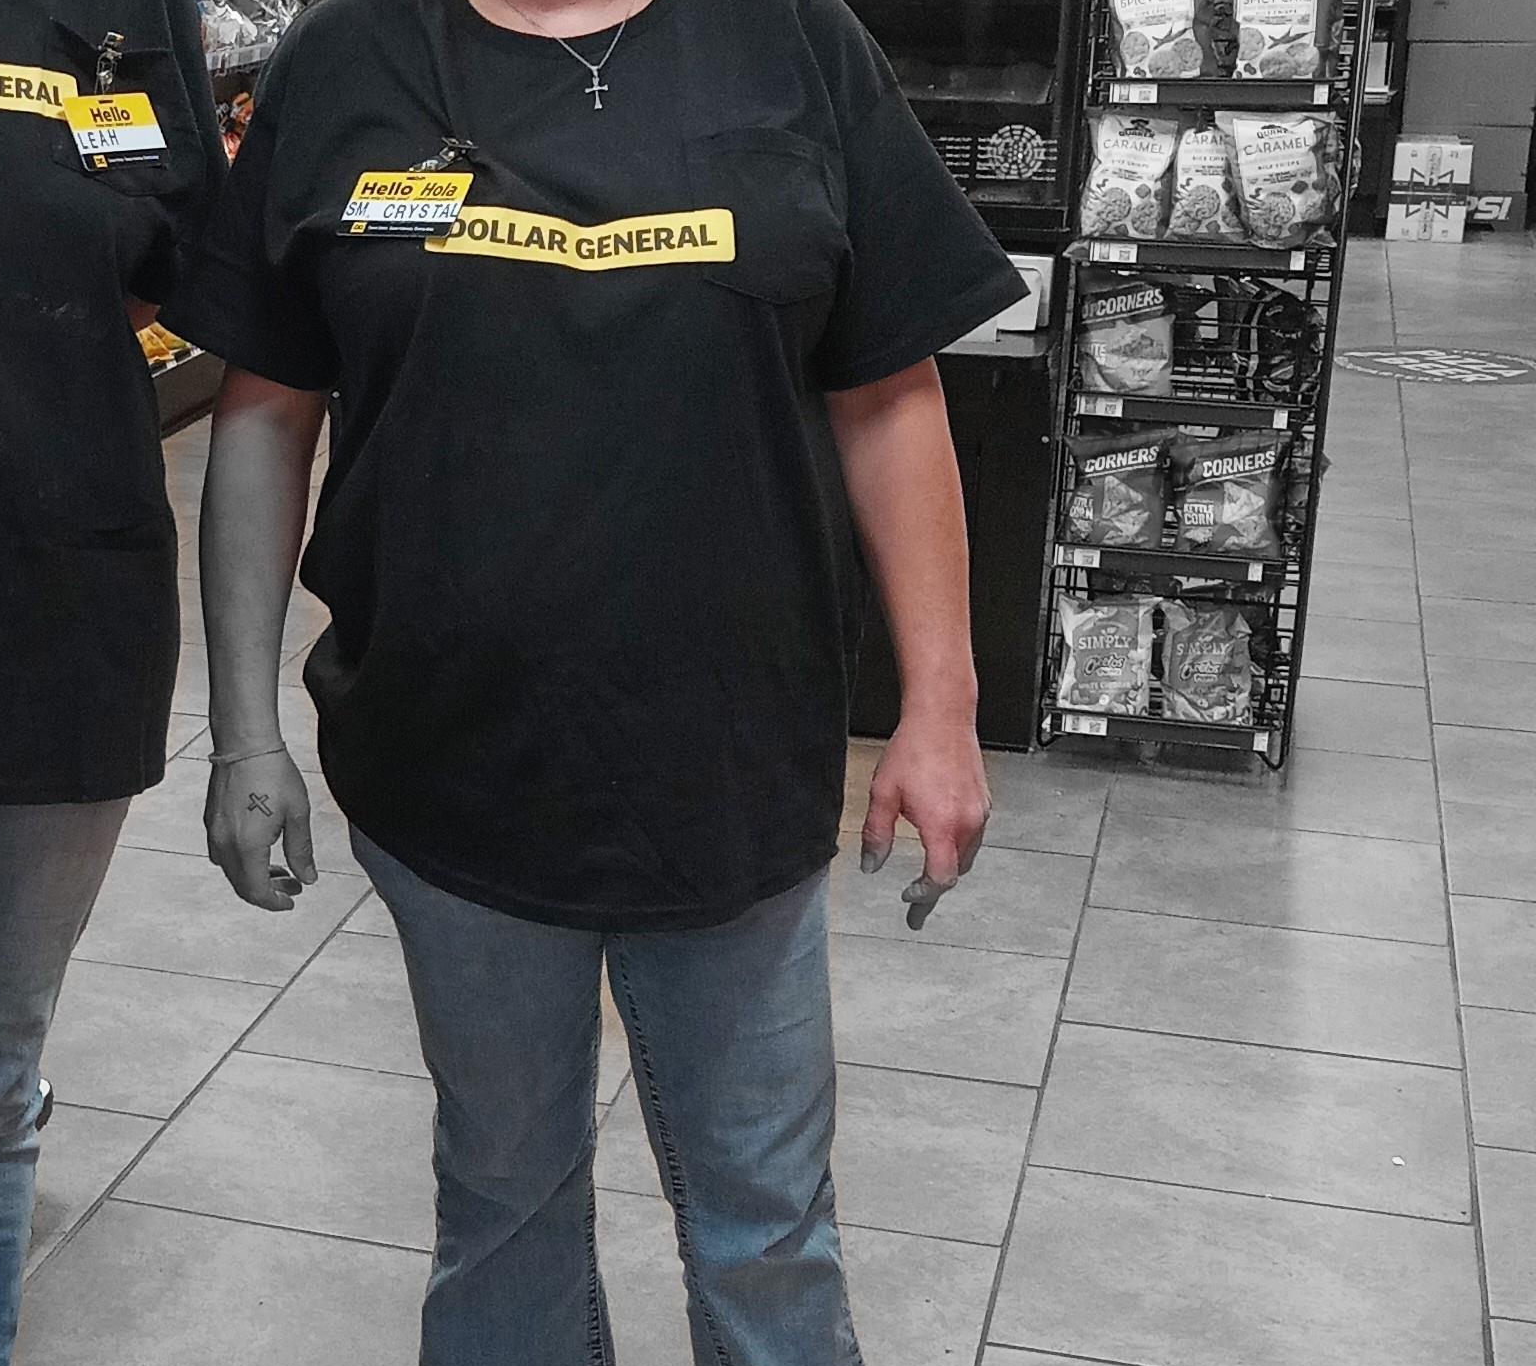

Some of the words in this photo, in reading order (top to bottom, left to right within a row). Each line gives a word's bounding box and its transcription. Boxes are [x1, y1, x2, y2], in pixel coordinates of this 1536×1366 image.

[90, 106, 131, 123] Hello
[77, 129, 119, 150] LEAH
[1103, 139, 1165, 154] CARAMEL
[1244, 137, 1311, 155] CARAMEL
[360, 182, 413, 196] Hello
[420, 182, 458, 197] Hola
[383, 202, 458, 219] CRYSTAL
[450, 218, 568, 255] DOLLAR
[575, 223, 718, 260] GENERAL
[1184, 512, 1214, 525] CORN
[1078, 636, 1131, 650] SIMPLY
